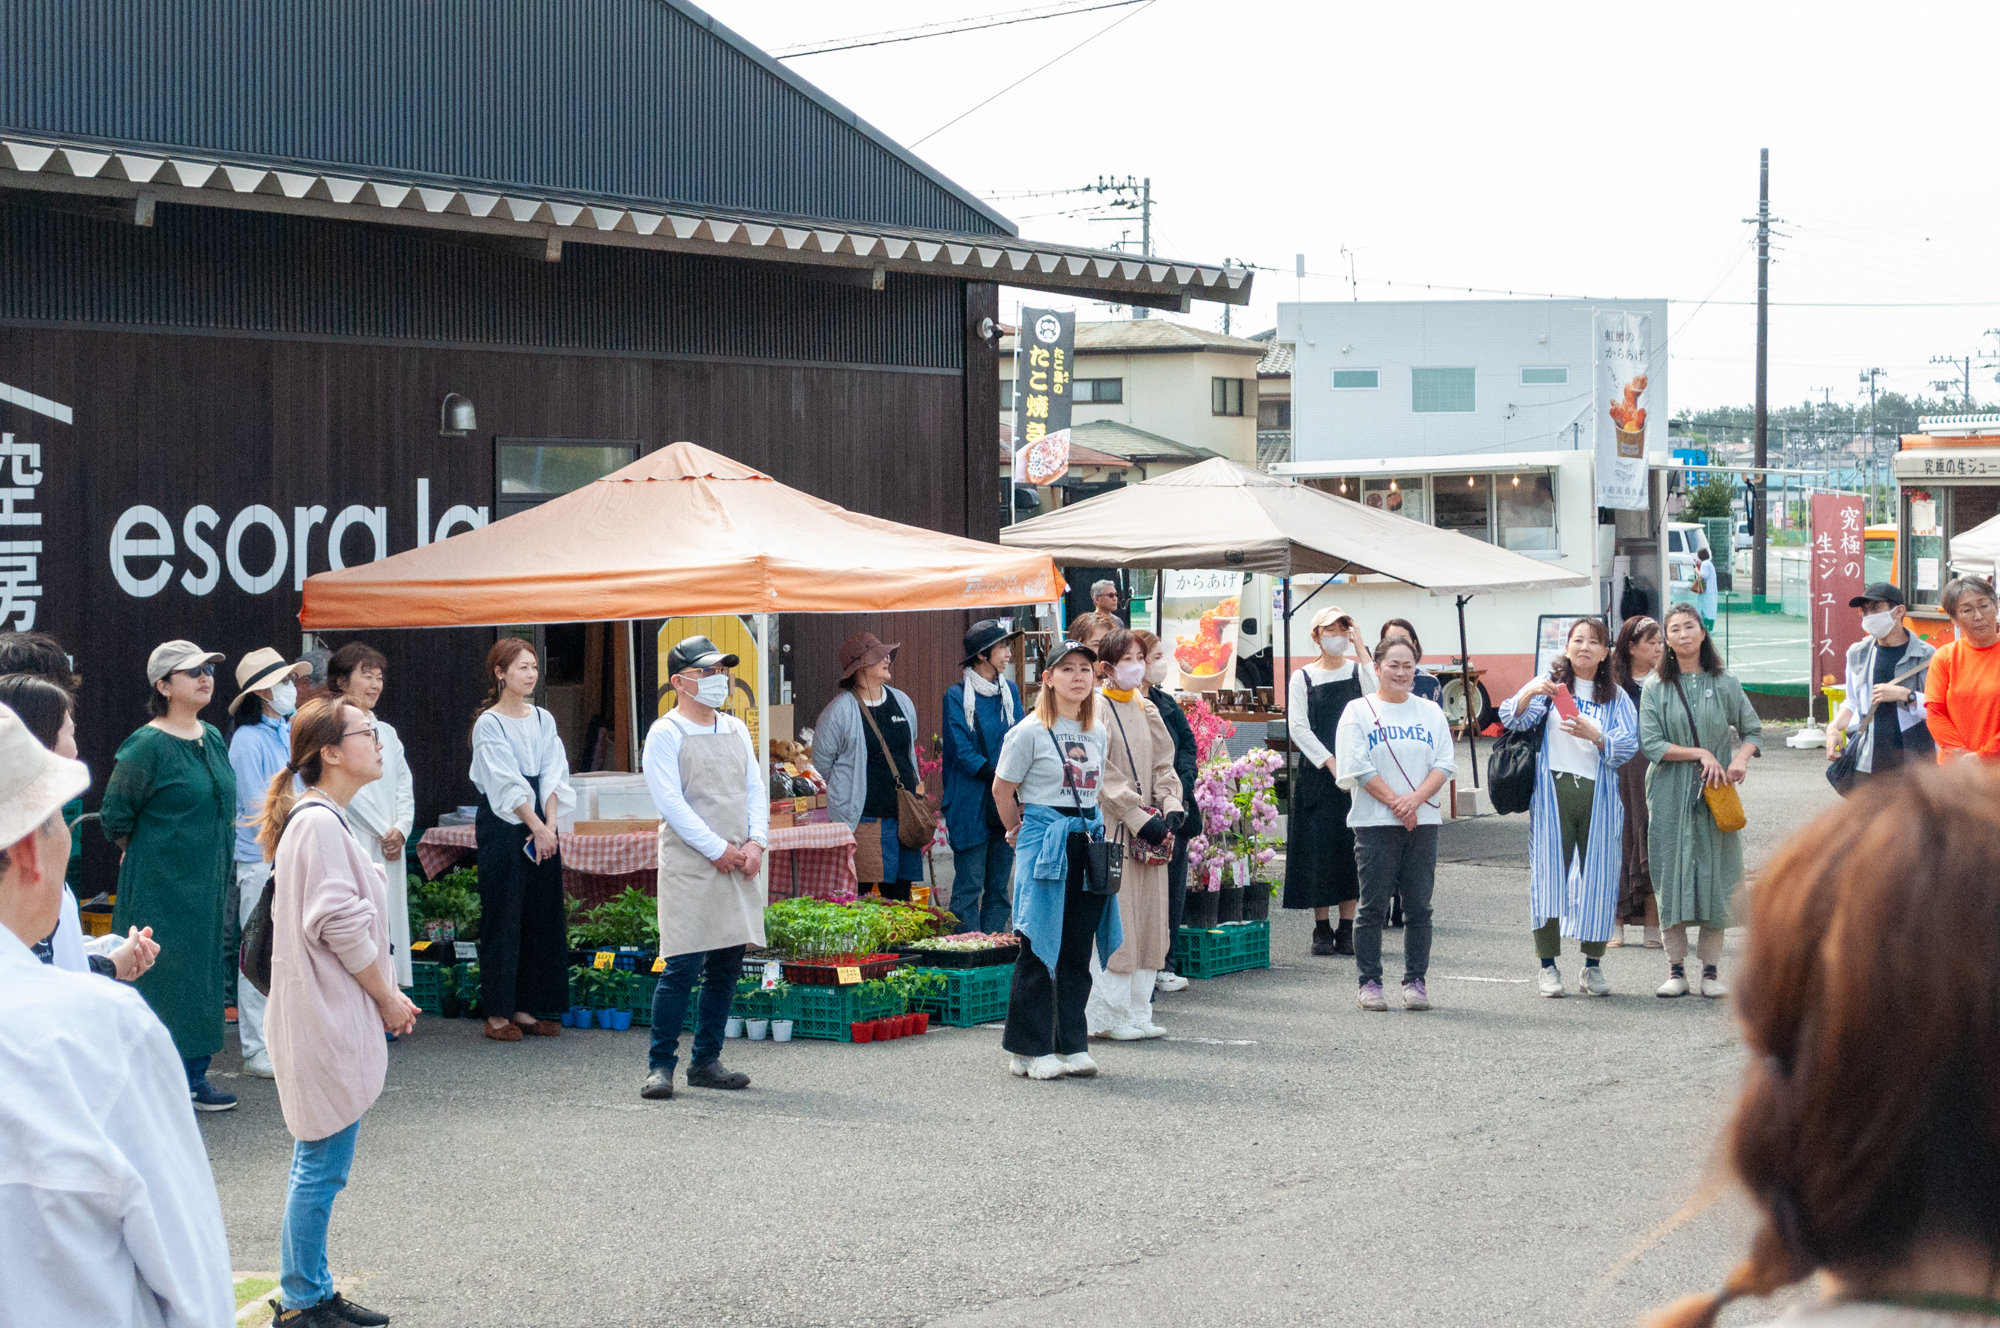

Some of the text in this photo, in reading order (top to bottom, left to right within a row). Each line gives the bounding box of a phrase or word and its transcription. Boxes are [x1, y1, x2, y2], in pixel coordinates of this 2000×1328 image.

[1605, 347, 1645, 361] からあげ
[1026, 345, 1050, 443] たこ焼き
[109, 504, 388, 598] esora
[1840, 506, 1861, 579] 究極の
[1176, 572, 1238, 590] からあげ
[1816, 531, 1837, 656] 生ジュース
[1367, 723, 1434, 751] NOUMÉA
[280, 1309, 302, 1322] PUMA
